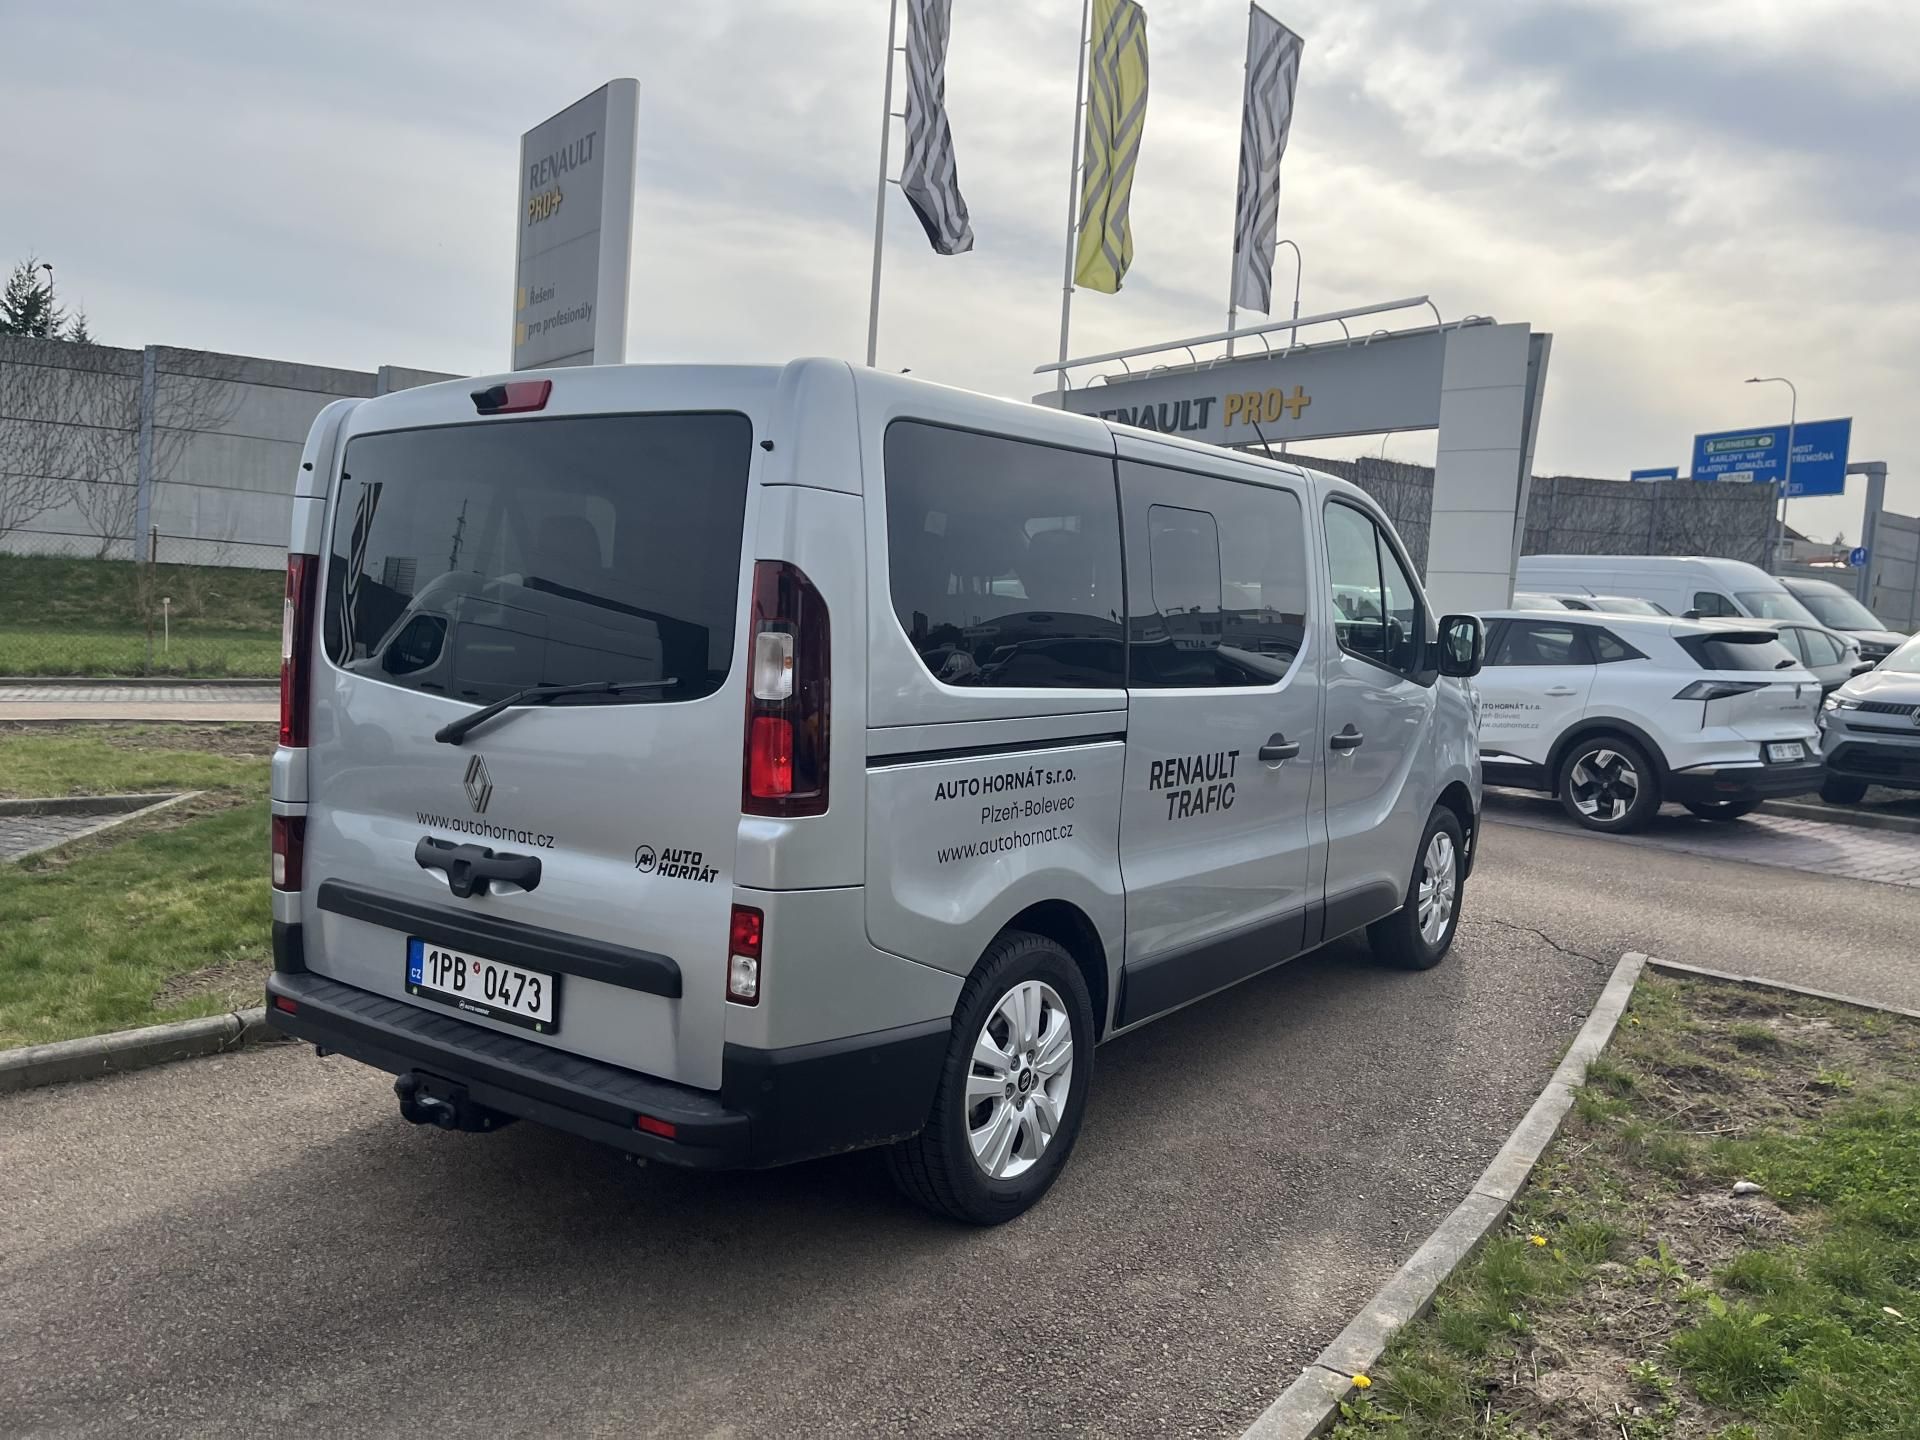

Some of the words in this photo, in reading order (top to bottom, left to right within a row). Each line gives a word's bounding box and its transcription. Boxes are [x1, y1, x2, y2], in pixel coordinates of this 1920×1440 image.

[530, 131, 597, 191] RENAULT
[528, 186, 562, 227] PRO+
[528, 321, 541, 340] pro
[543, 302, 593, 334] profesionály
[1081, 397, 1216, 433] NAULT
[1224, 385, 1311, 427] PRO+
[1697, 463, 1728, 473] KLATOVY
[1710, 452, 1743, 464] KARLOVY
[1746, 451, 1766, 460] VARY
[1495, 701, 1524, 710] HORNÁT
[934, 780, 980, 801] AUTO
[982, 766, 1044, 795] HORNÁT
[1046, 767, 1077, 785] s.r.o.
[1149, 750, 1240, 791] RENAULT
[981, 794, 1075, 825] Plzeň-Bolevec
[1166, 782, 1236, 821] TRAFIC
[416, 810, 555, 849] www.autohornat.cz
[937, 823, 1073, 864] www.autohornat.cz
[657, 862, 719, 883] HORNÁT
[661, 848, 703, 866] AUTO
[411, 967, 422, 979] CZ
[429, 950, 467, 992] 1PB
[484, 965, 542, 1013] 0473
